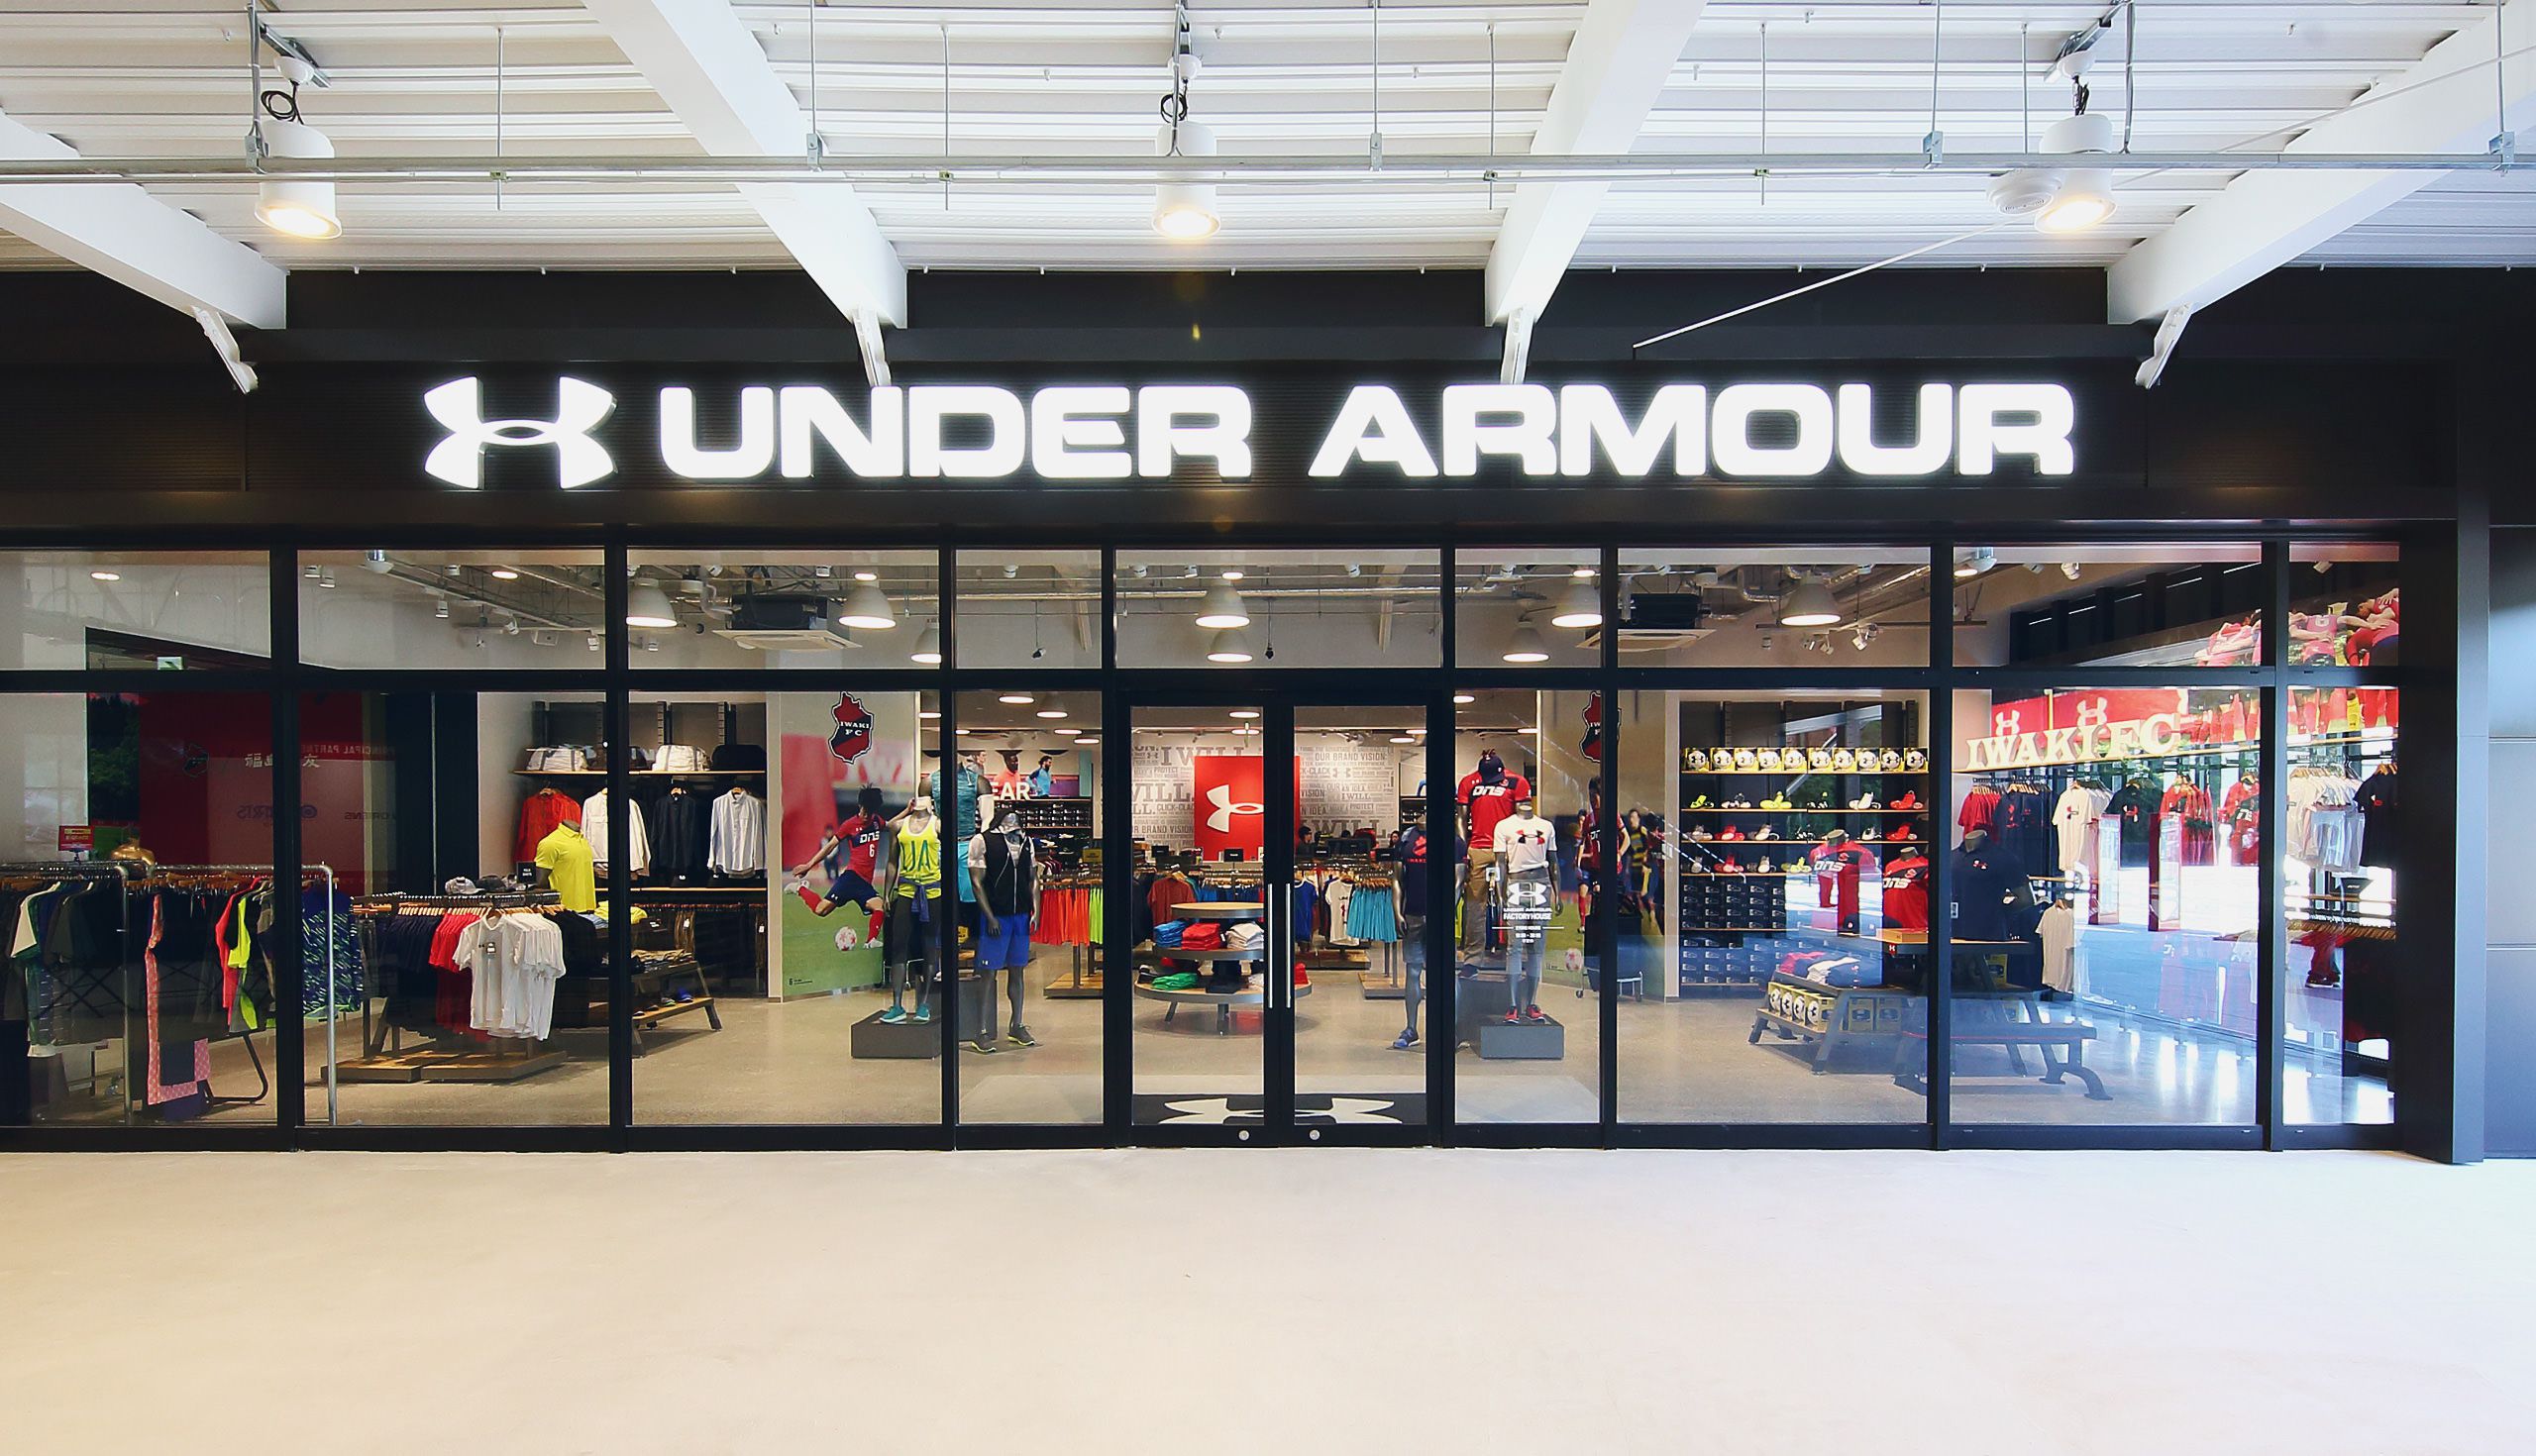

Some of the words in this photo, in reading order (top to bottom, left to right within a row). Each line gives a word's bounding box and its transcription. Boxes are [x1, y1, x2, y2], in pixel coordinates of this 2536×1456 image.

[660, 385, 1252, 479] UNDER
[1308, 383, 2074, 477] ARMOUR
[1966, 724, 2098, 770] IWAKI
[2106, 713, 2177, 759] FC
[869, 843, 876, 858] 6
